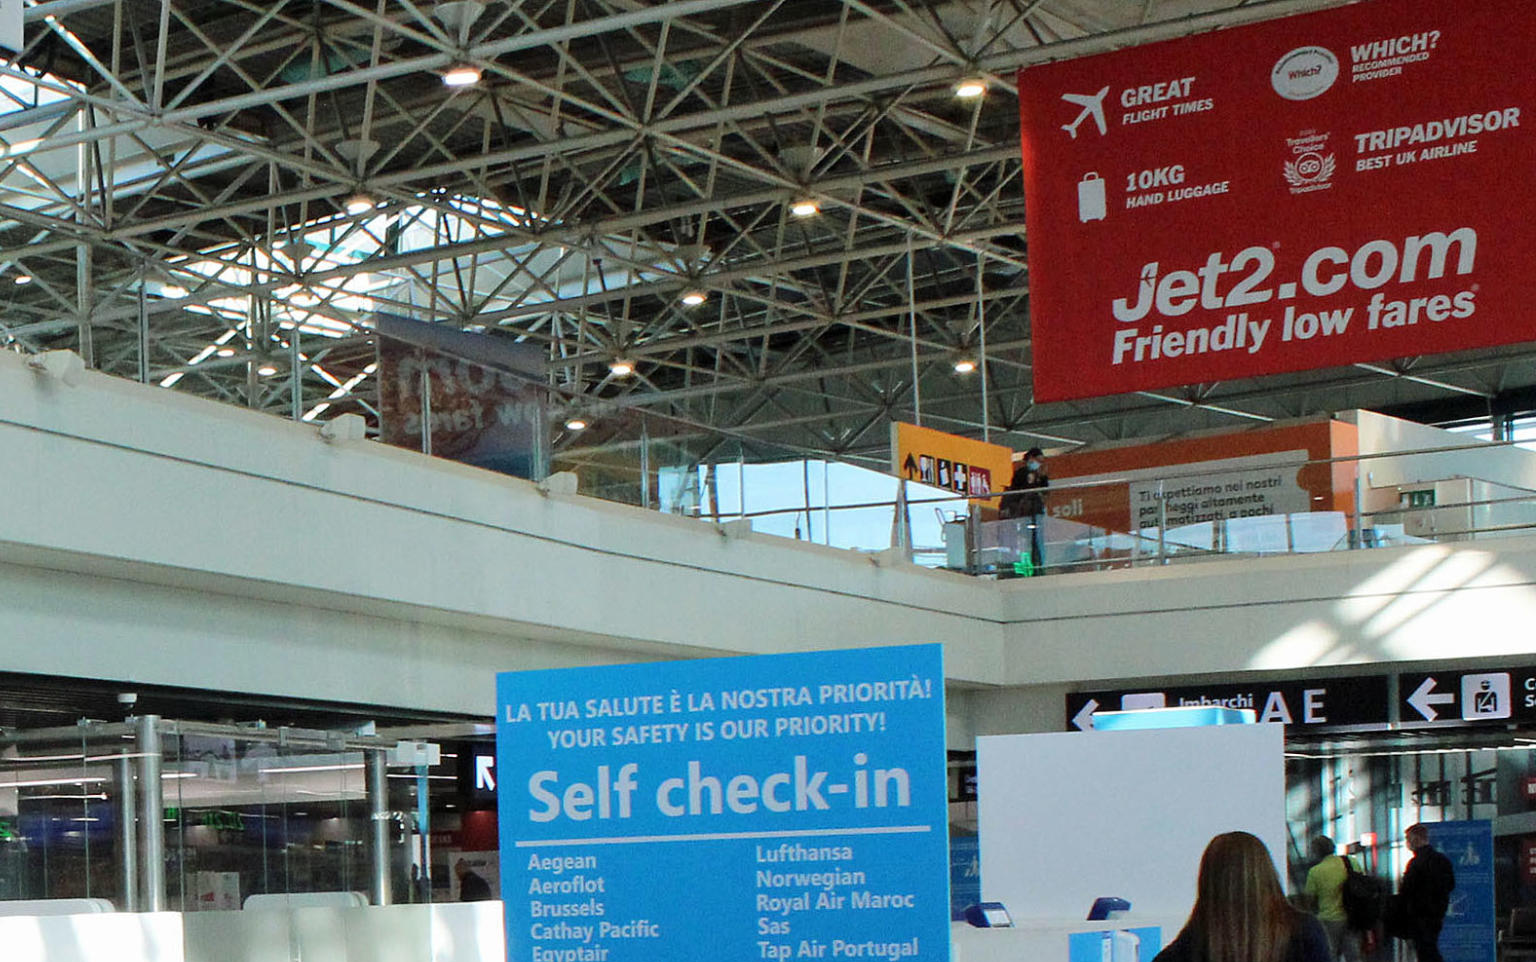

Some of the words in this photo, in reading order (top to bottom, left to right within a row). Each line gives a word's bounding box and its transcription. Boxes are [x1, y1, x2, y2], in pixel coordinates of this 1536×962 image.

[1350, 30, 1441, 63] WHICH?
[1288, 64, 1322, 80] Which?
[1352, 52, 1429, 73] RECOMMENDED
[1352, 67, 1402, 83] PROVIDER
[1120, 77, 1196, 108] GREAT
[1122, 107, 1169, 125] FLIGHT
[1172, 98, 1214, 116] TIMES
[1355, 107, 1521, 154] TRIPADVISOR
[1356, 154, 1392, 172] BEST
[1396, 149, 1417, 166] UK
[1419, 140, 1478, 161] AIRLINE
[1126, 165, 1185, 192] 10KG
[1126, 193, 1163, 209] HAND
[1167, 181, 1230, 202] LUGGAGE
[1112, 312, 1271, 366] Friendly
[1281, 305, 1354, 341] low
[1367, 289, 1477, 331] fares
[1138, 490, 1150, 502] Ti
[1225, 480, 1243, 492] nei
[1246, 475, 1282, 489] nostri
[1139, 500, 1198, 518] parheggi
[1201, 494, 1264, 508] altamente
[505, 703, 531, 723] LA
[537, 701, 579, 721] TUA
[585, 695, 663, 717] SALUTE
[669, 690, 681, 713] È
[688, 692, 714, 712] LA
[721, 687, 812, 710] NOSTRA
[820, 674, 932, 703] PRIORITÀ!
[1261, 691, 1293, 724] A
[1304, 688, 1327, 724] E
[547, 728, 606, 750] YOUR
[611, 725, 689, 746] SAFETY
[696, 722, 714, 741] IS
[720, 719, 768, 740] OUR
[777, 712, 886, 736] PRIORITY!
[528, 763, 638, 823] Self
[656, 753, 911, 817] check-in
[528, 853, 596, 874] Aegean
[756, 845, 853, 863] Lufthansa
[529, 876, 605, 895] Aeroflot
[756, 868, 865, 890] Norwegian
[531, 899, 604, 918] Brussels
[756, 893, 809, 915] Royal
[815, 892, 846, 911] Air
[852, 891, 914, 909] Maroc
[531, 923, 594, 943] Cathay
[600, 920, 659, 939] Pacific
[758, 917, 790, 935] Sas
[758, 942, 790, 962] Tap
[797, 940, 826, 957] Air
[832, 938, 918, 961] Portugal
